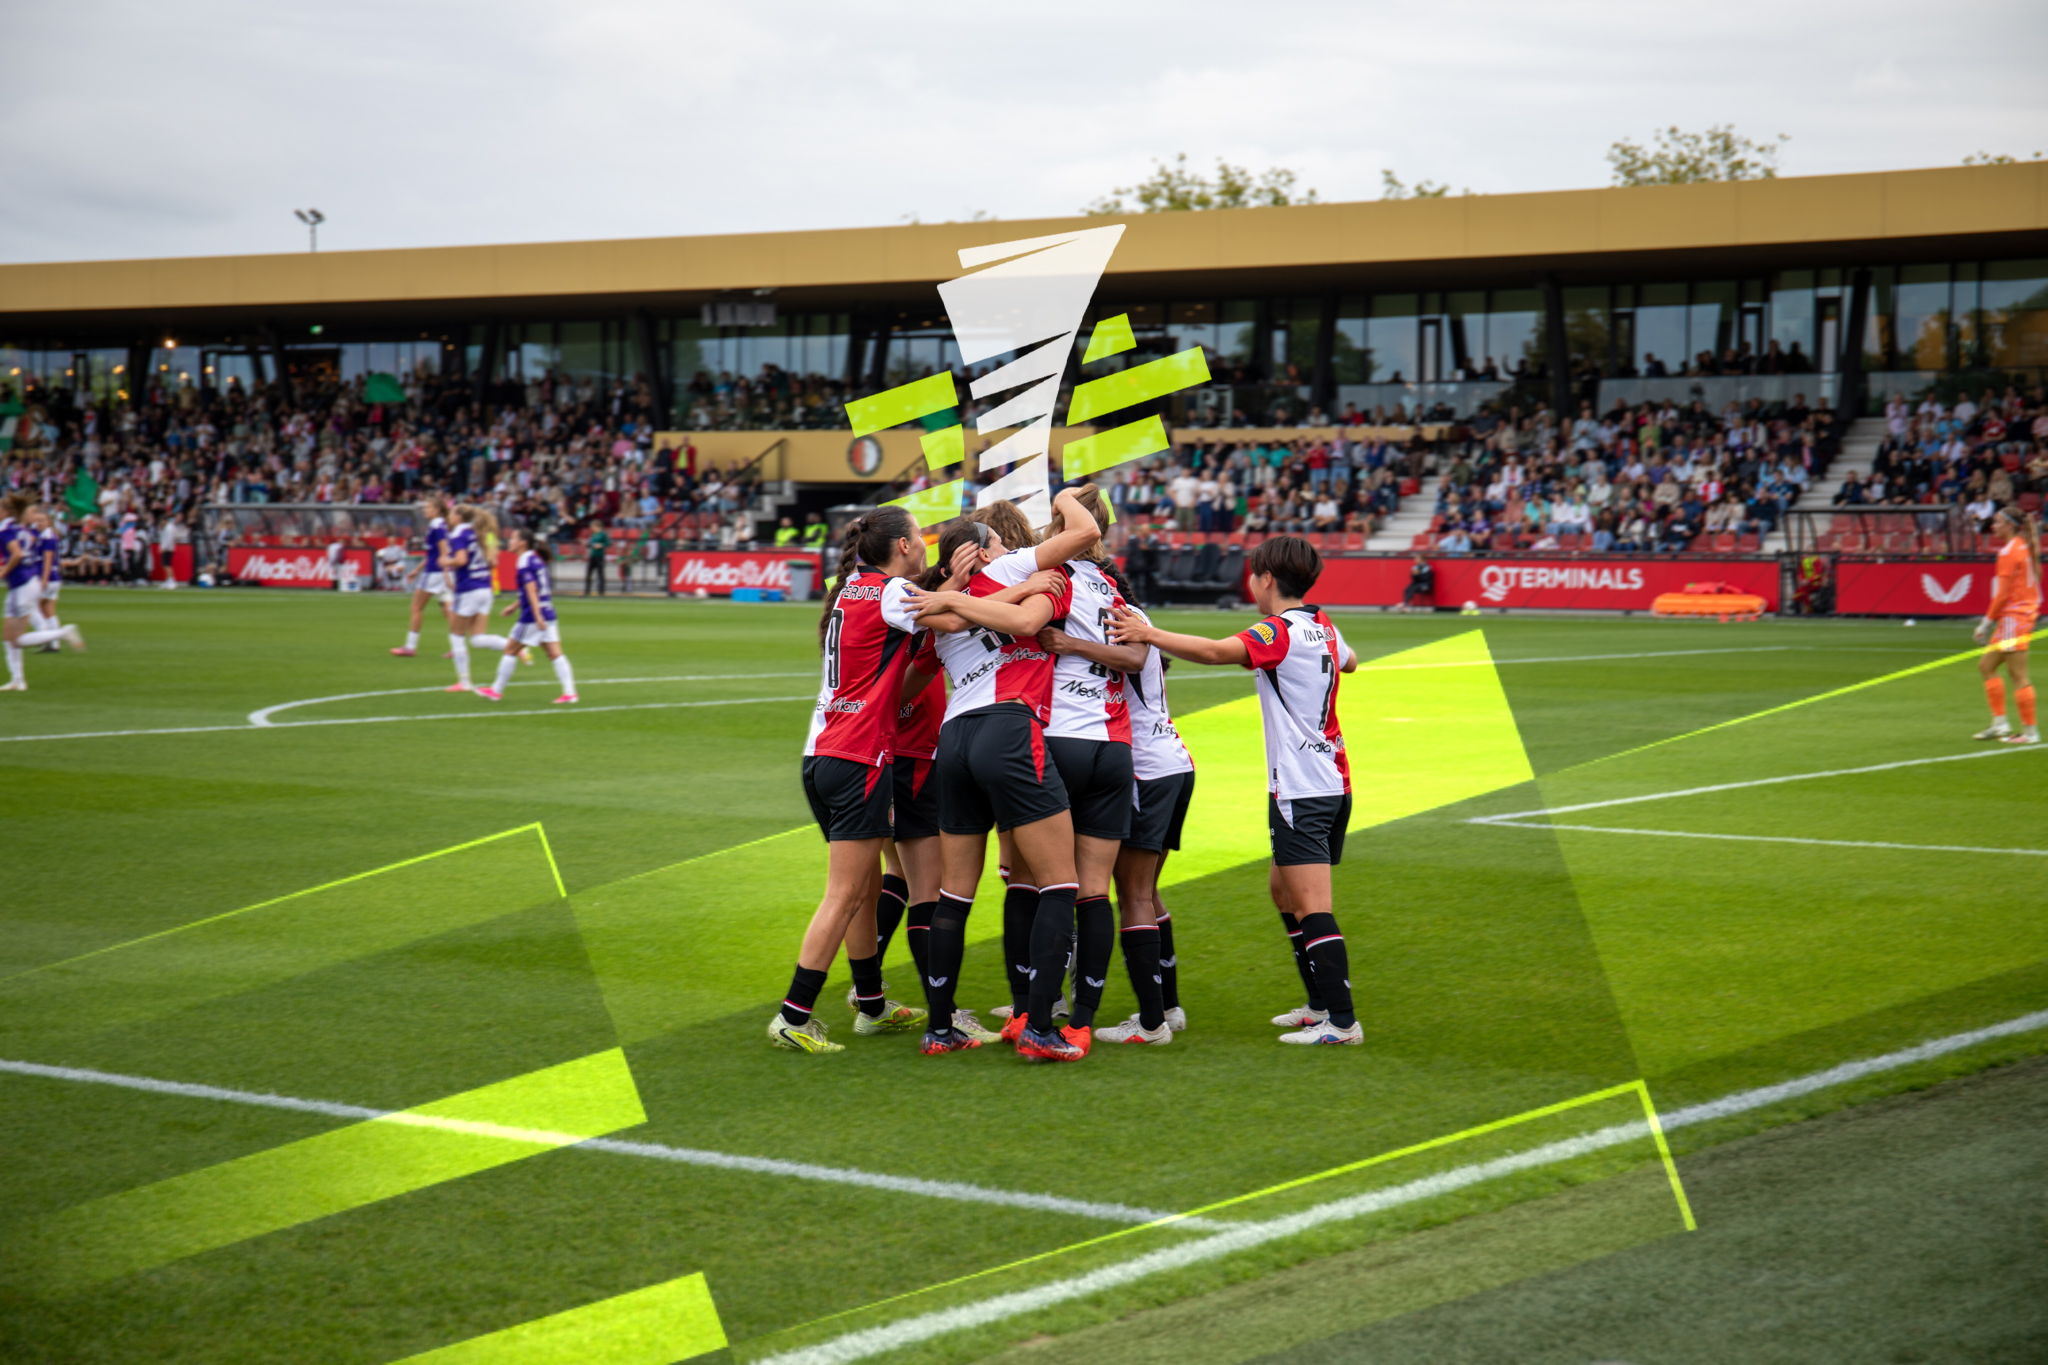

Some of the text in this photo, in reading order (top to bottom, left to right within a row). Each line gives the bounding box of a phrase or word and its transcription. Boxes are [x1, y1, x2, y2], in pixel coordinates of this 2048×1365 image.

[1480, 565, 1644, 602] QTERMINALS
[828, 608, 844, 689] 9
[1318, 654, 1336, 731] 7
